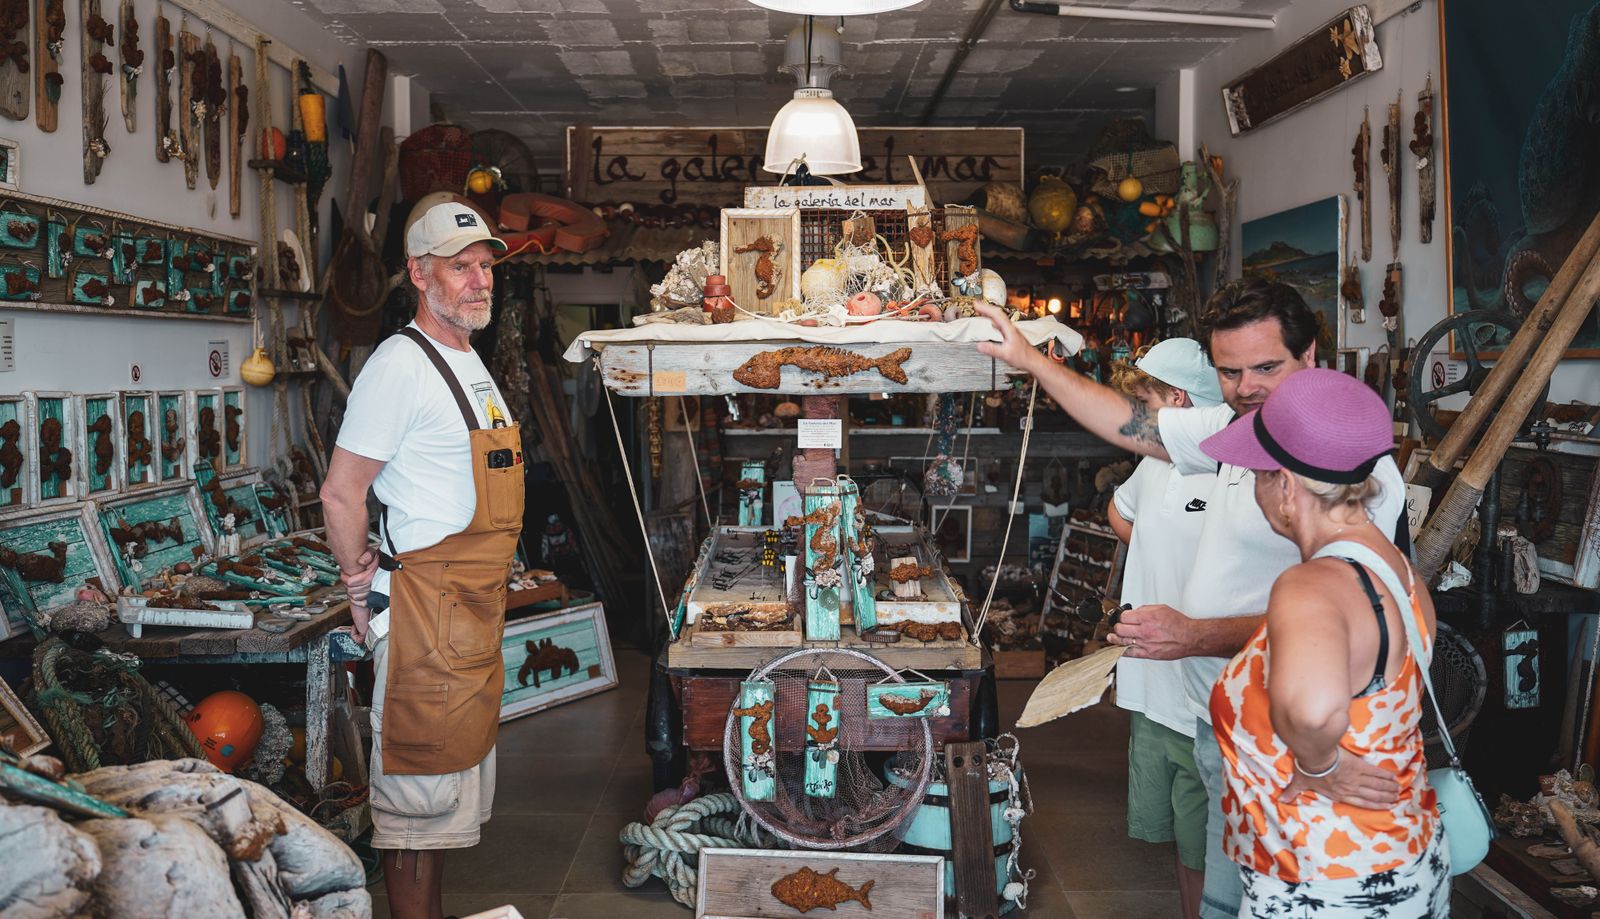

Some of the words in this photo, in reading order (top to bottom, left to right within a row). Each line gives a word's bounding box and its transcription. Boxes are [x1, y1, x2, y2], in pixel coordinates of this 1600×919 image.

[592, 135, 645, 184] la
[660, 133, 767, 205] galer
[845, 134, 900, 184] el
[921, 155, 1011, 184] mar
[774, 194, 791, 208] la
[845, 192, 865, 207] del
[869, 197, 896, 207] mar
